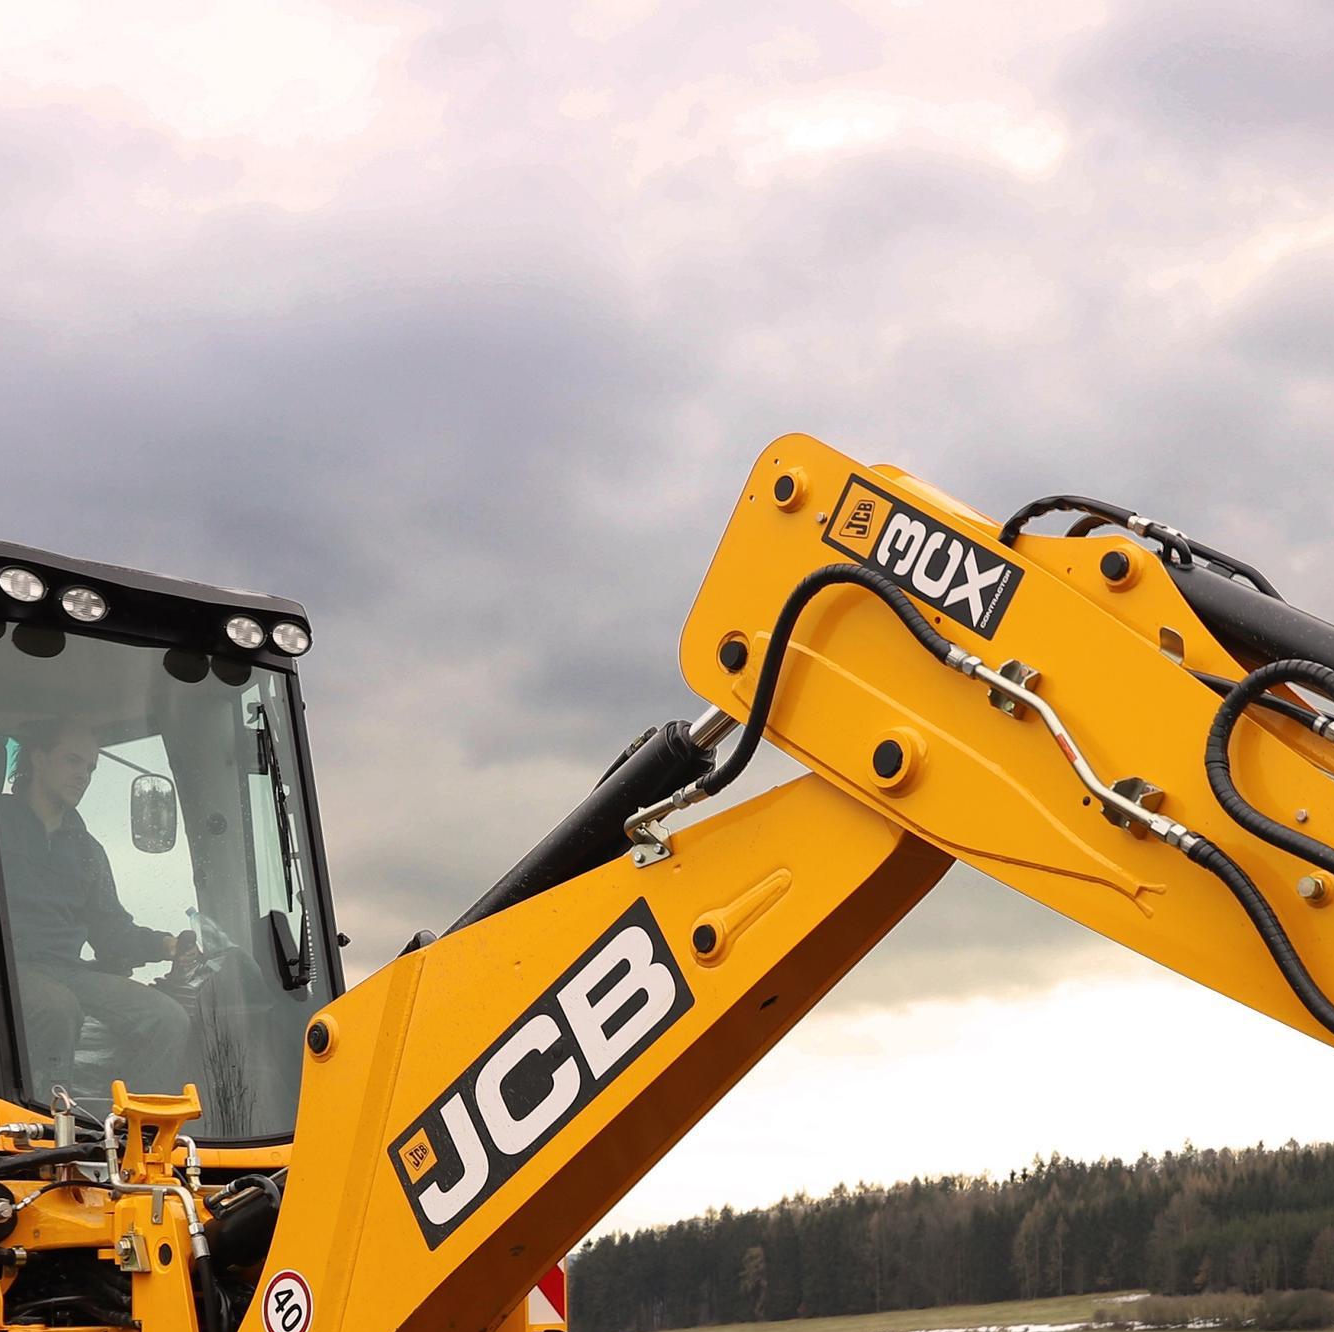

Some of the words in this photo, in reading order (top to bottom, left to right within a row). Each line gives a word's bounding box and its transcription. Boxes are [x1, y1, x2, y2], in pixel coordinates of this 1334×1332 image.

[845, 501, 873, 536] JCB
[979, 569, 1013, 629] CONTRACTOR
[418, 925, 676, 1225] JCB
[408, 1144, 428, 1168] JCB
[274, 1288, 302, 1332] 40
